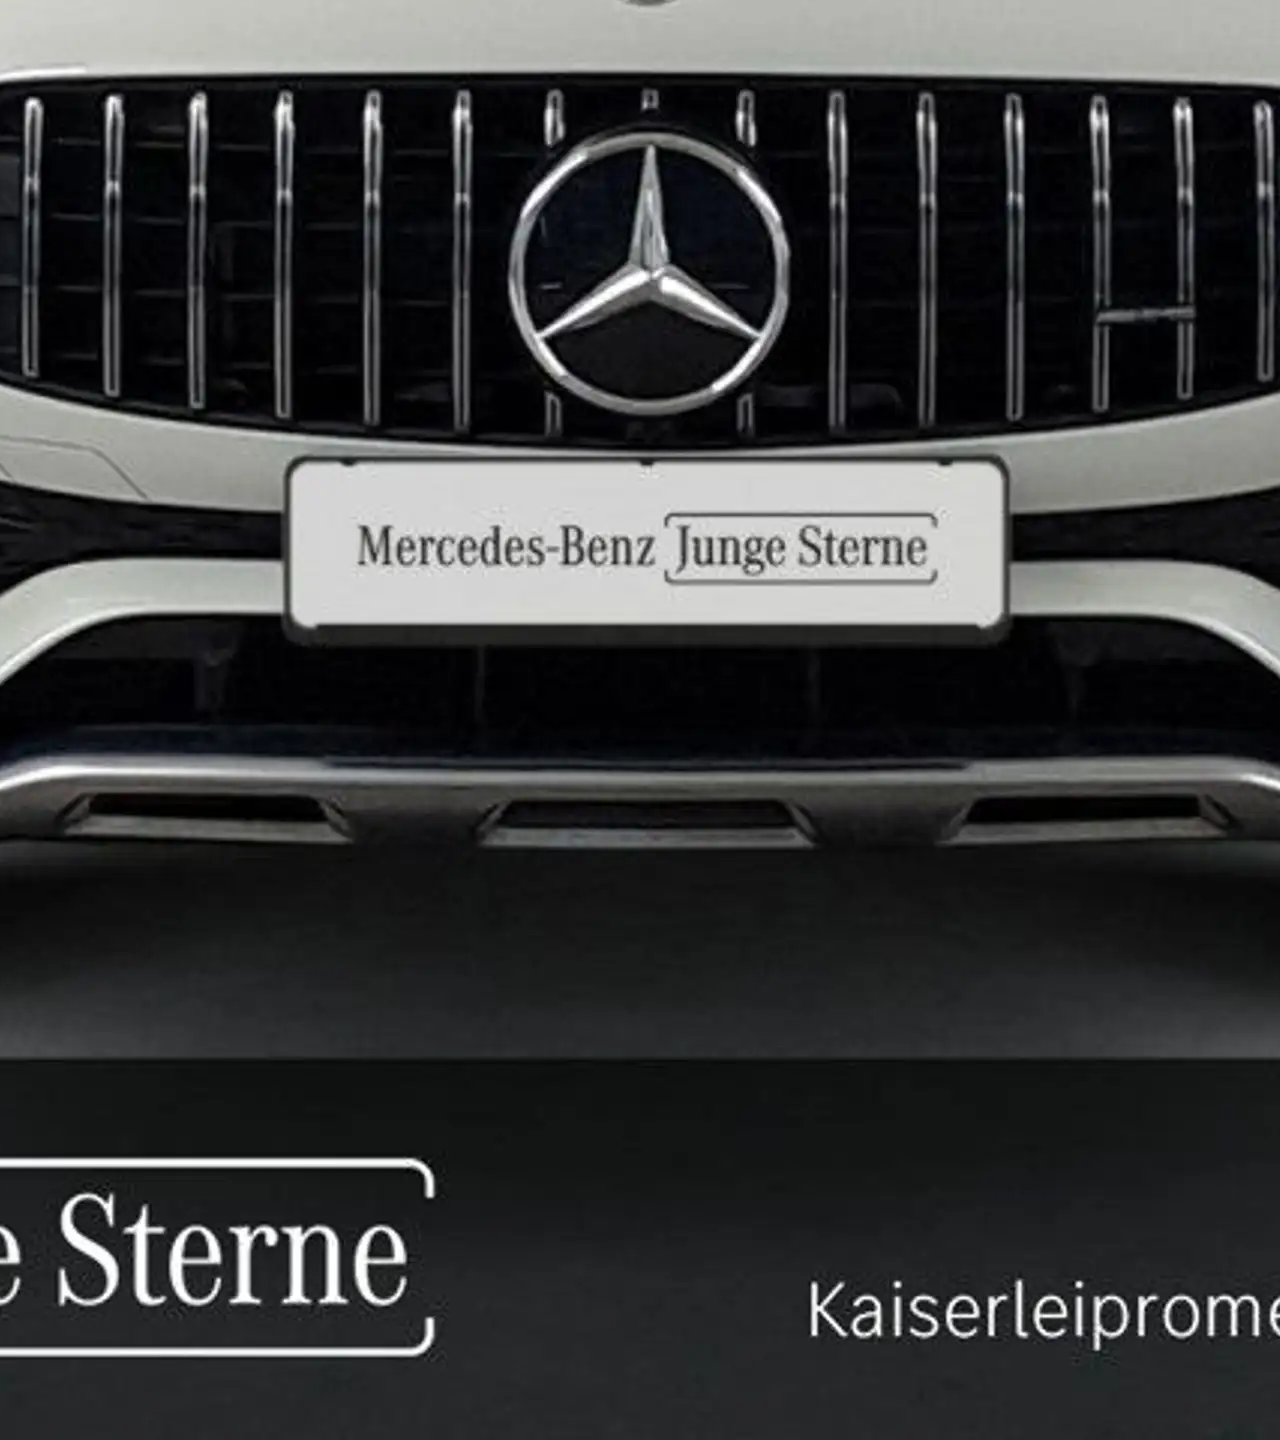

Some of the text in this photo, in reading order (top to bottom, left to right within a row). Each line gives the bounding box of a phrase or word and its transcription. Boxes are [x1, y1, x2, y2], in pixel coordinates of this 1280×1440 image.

[357, 524, 929, 576] Mercedes-Benz Junge Sterne
